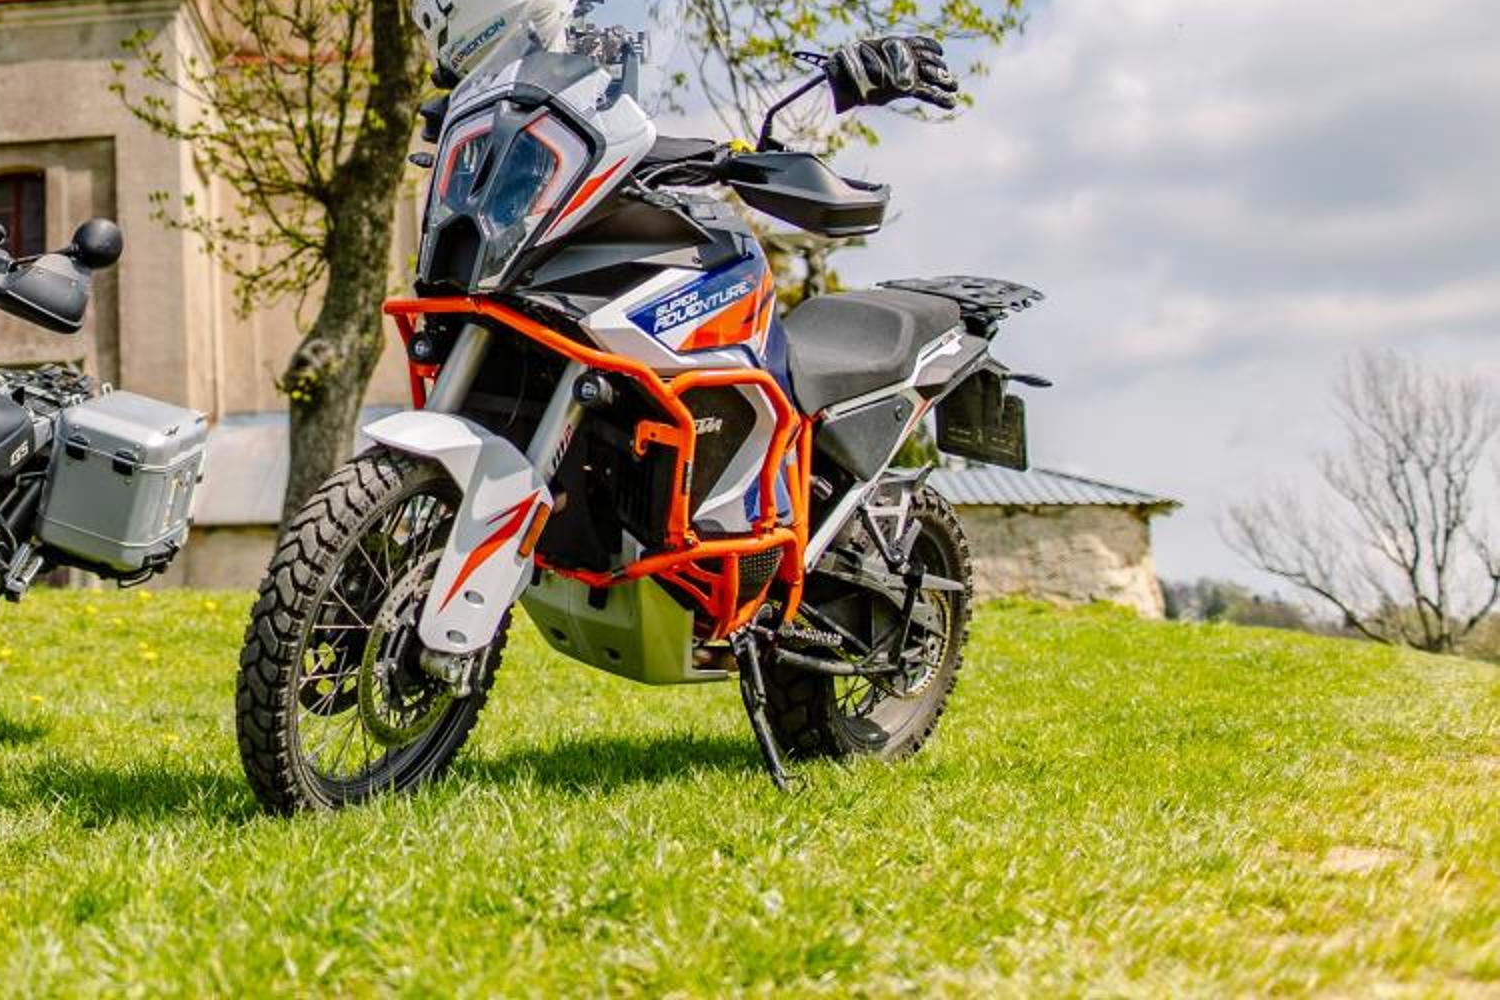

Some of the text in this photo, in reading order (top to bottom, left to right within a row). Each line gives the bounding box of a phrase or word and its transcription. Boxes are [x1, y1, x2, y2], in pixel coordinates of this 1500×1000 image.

[653, 281, 751, 333] ADVENTURE
[656, 291, 699, 317] SUPER
[10, 440, 29, 466] GS
